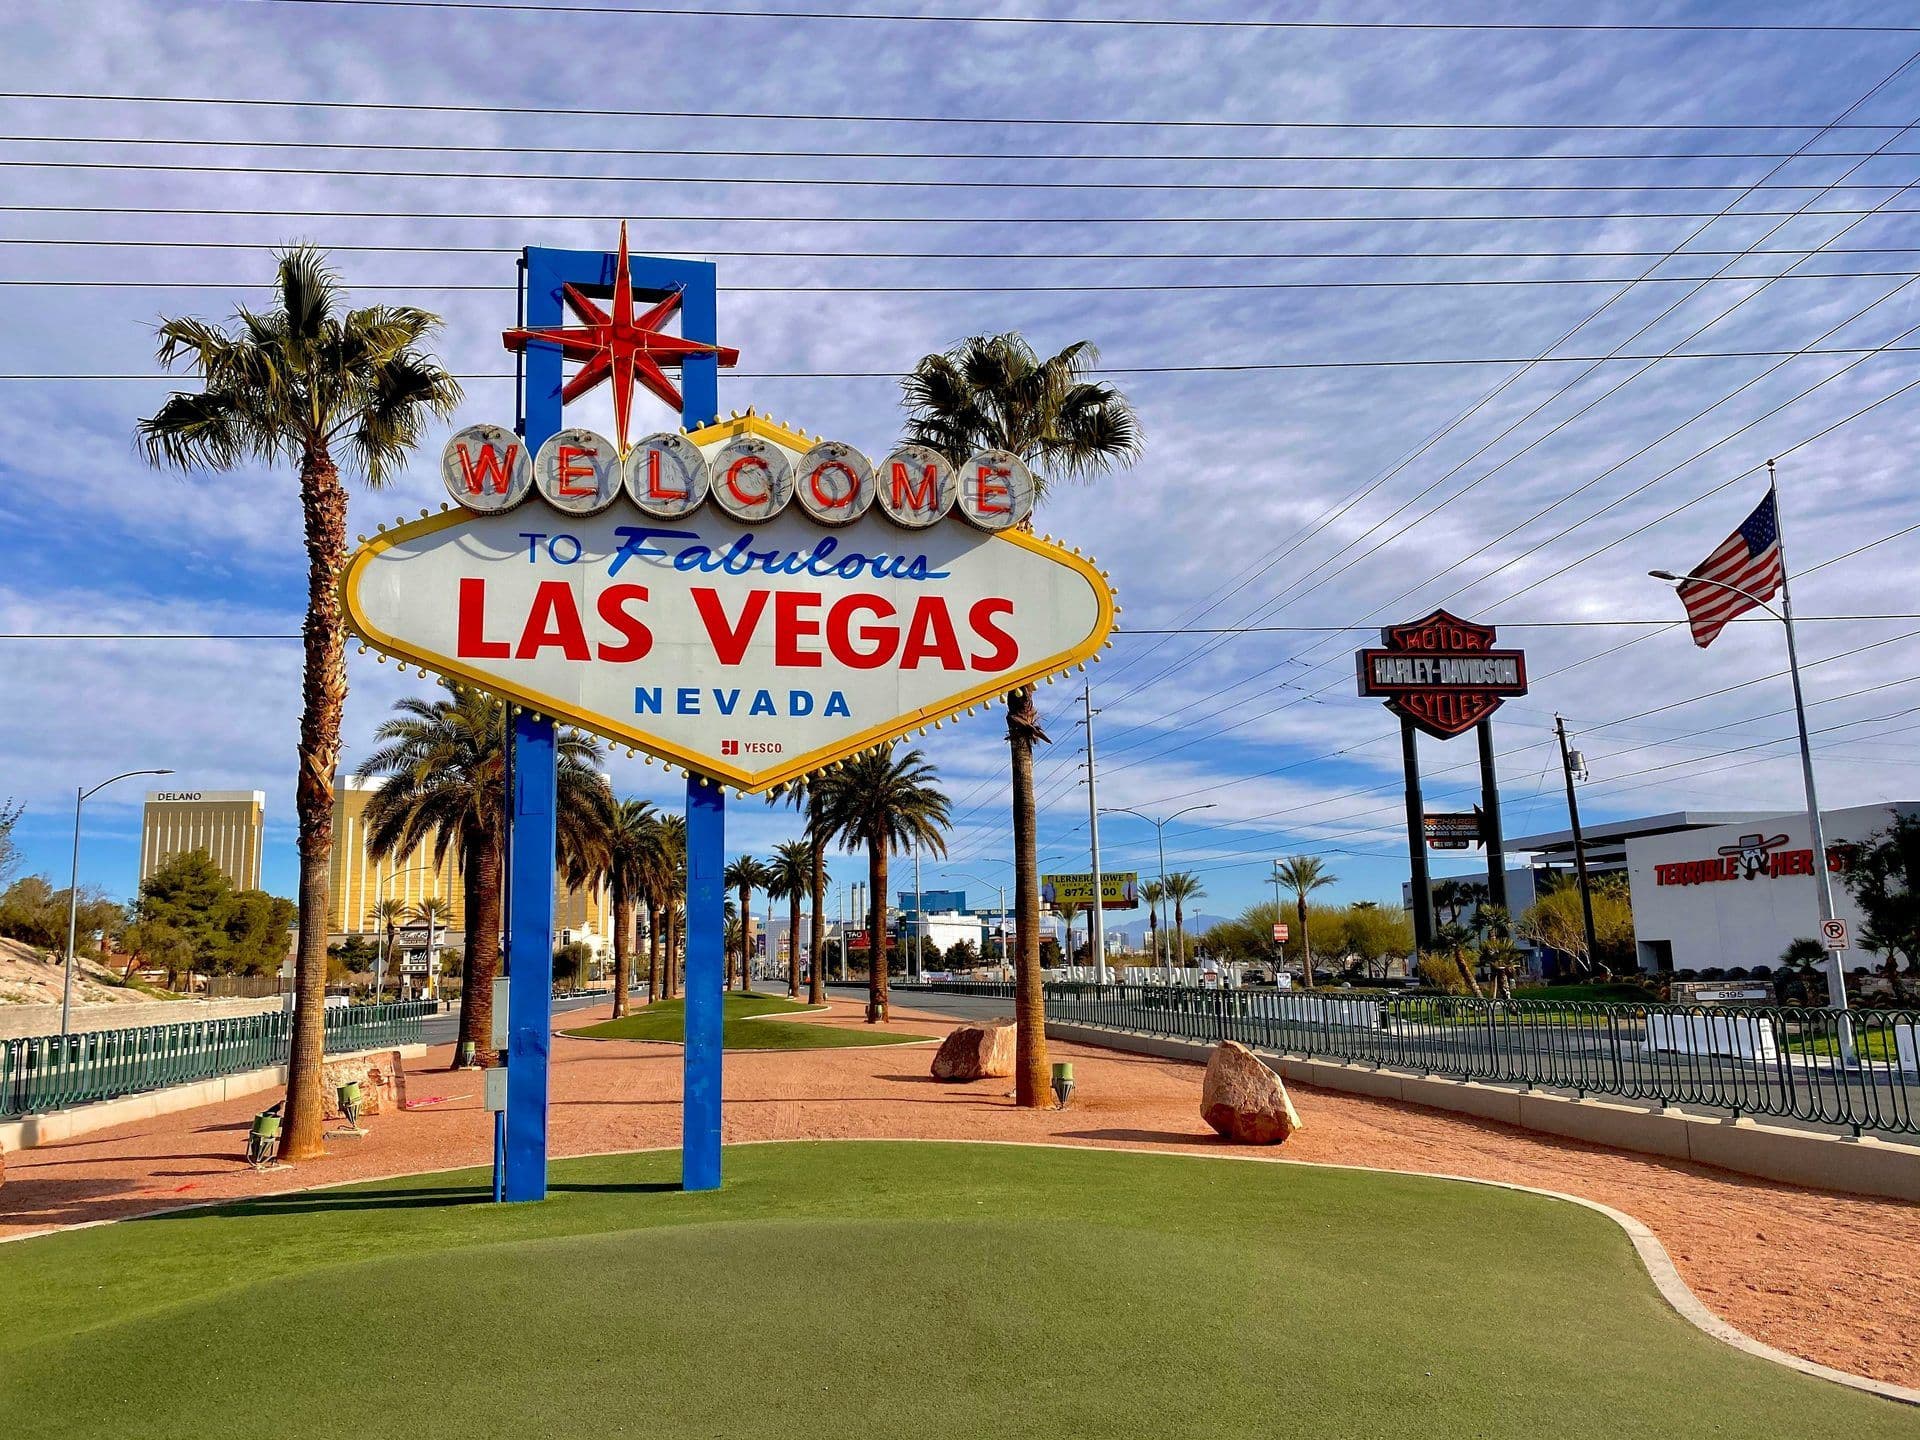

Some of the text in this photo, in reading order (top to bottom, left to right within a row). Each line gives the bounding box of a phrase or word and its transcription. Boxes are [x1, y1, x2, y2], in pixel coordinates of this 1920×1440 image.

[456, 443, 1011, 513] WELCOME
[519, 525, 951, 581] TO Fabulous
[457, 577, 1019, 672] LAS VEGAS
[1406, 623, 1481, 649] MOTOR
[1374, 658, 1518, 684] HARLEY-DAVIDSON
[633, 686, 851, 718] NEVADA
[1411, 692, 1487, 725] CYCLES
[744, 742, 782, 754] YESCO
[158, 792, 202, 801] DELANO
[1055, 874, 1090, 883] LERNER
[1654, 844, 1855, 886] TERRIBLE HERS
[1064, 887, 1117, 897] 877-100
